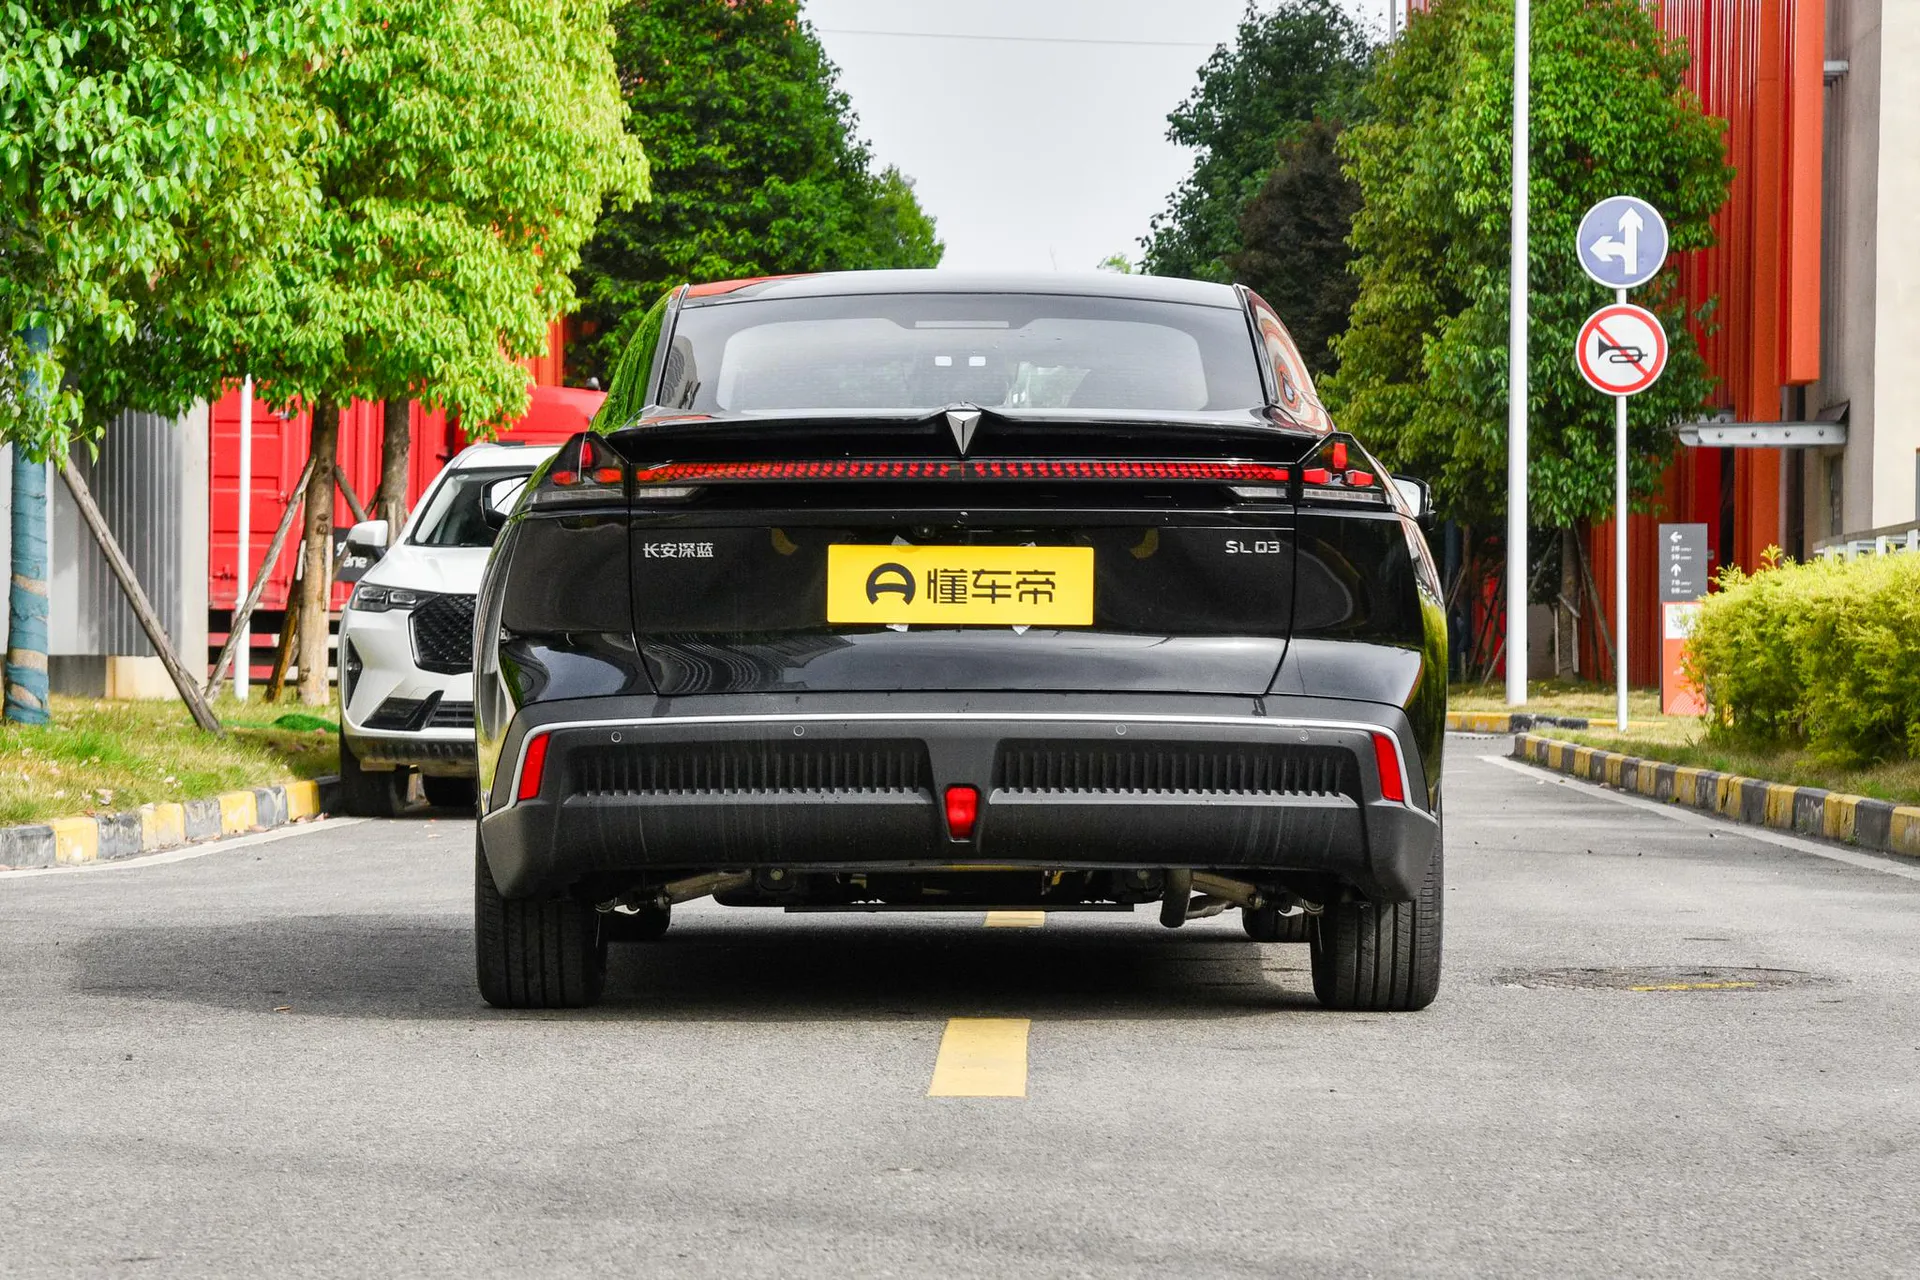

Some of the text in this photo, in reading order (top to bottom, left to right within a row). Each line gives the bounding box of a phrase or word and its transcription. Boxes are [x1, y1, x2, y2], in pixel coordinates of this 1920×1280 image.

[643, 542, 714, 558] 长安深蓝
[927, 568, 1056, 605] 懂车帝
